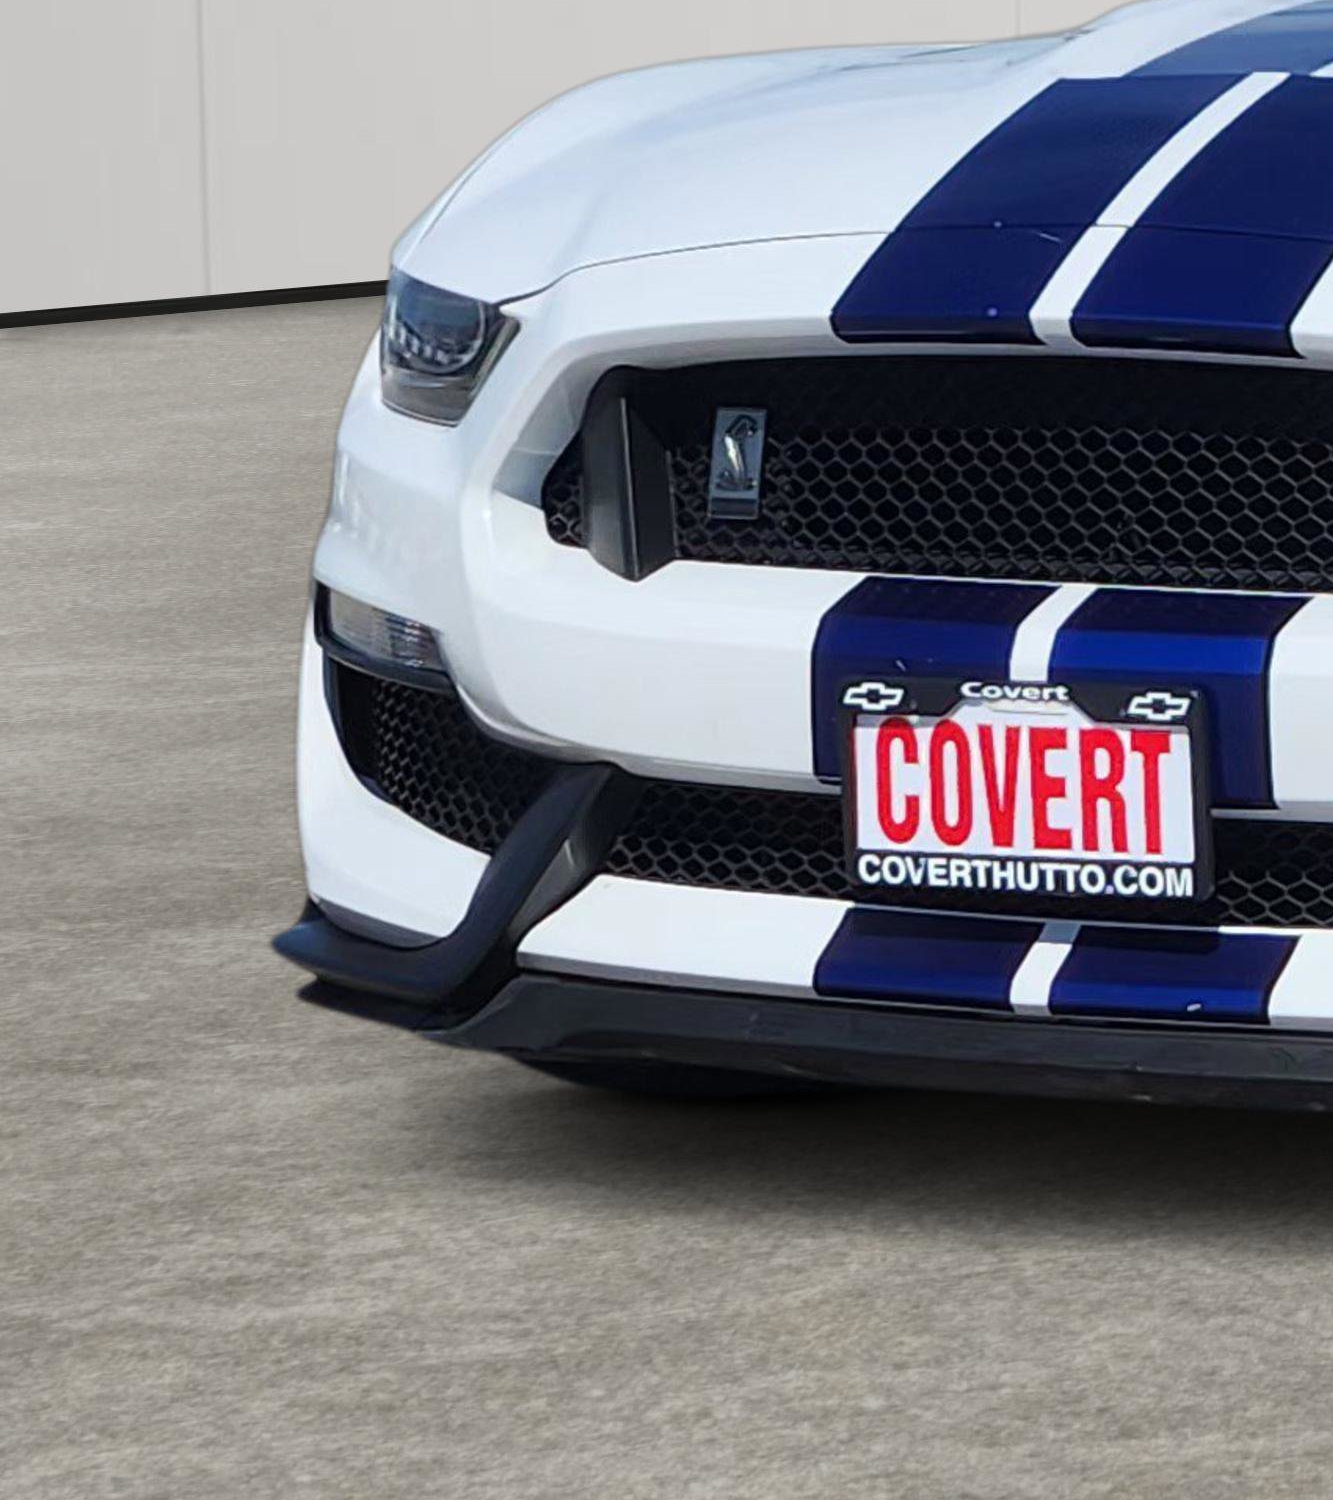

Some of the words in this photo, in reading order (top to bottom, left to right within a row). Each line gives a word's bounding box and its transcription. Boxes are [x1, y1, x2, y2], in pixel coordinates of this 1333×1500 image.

[960, 681, 1070, 702] Covert
[877, 717, 1170, 854] COVERT
[857, 854, 1194, 897] COVERTHUTTO.COM
